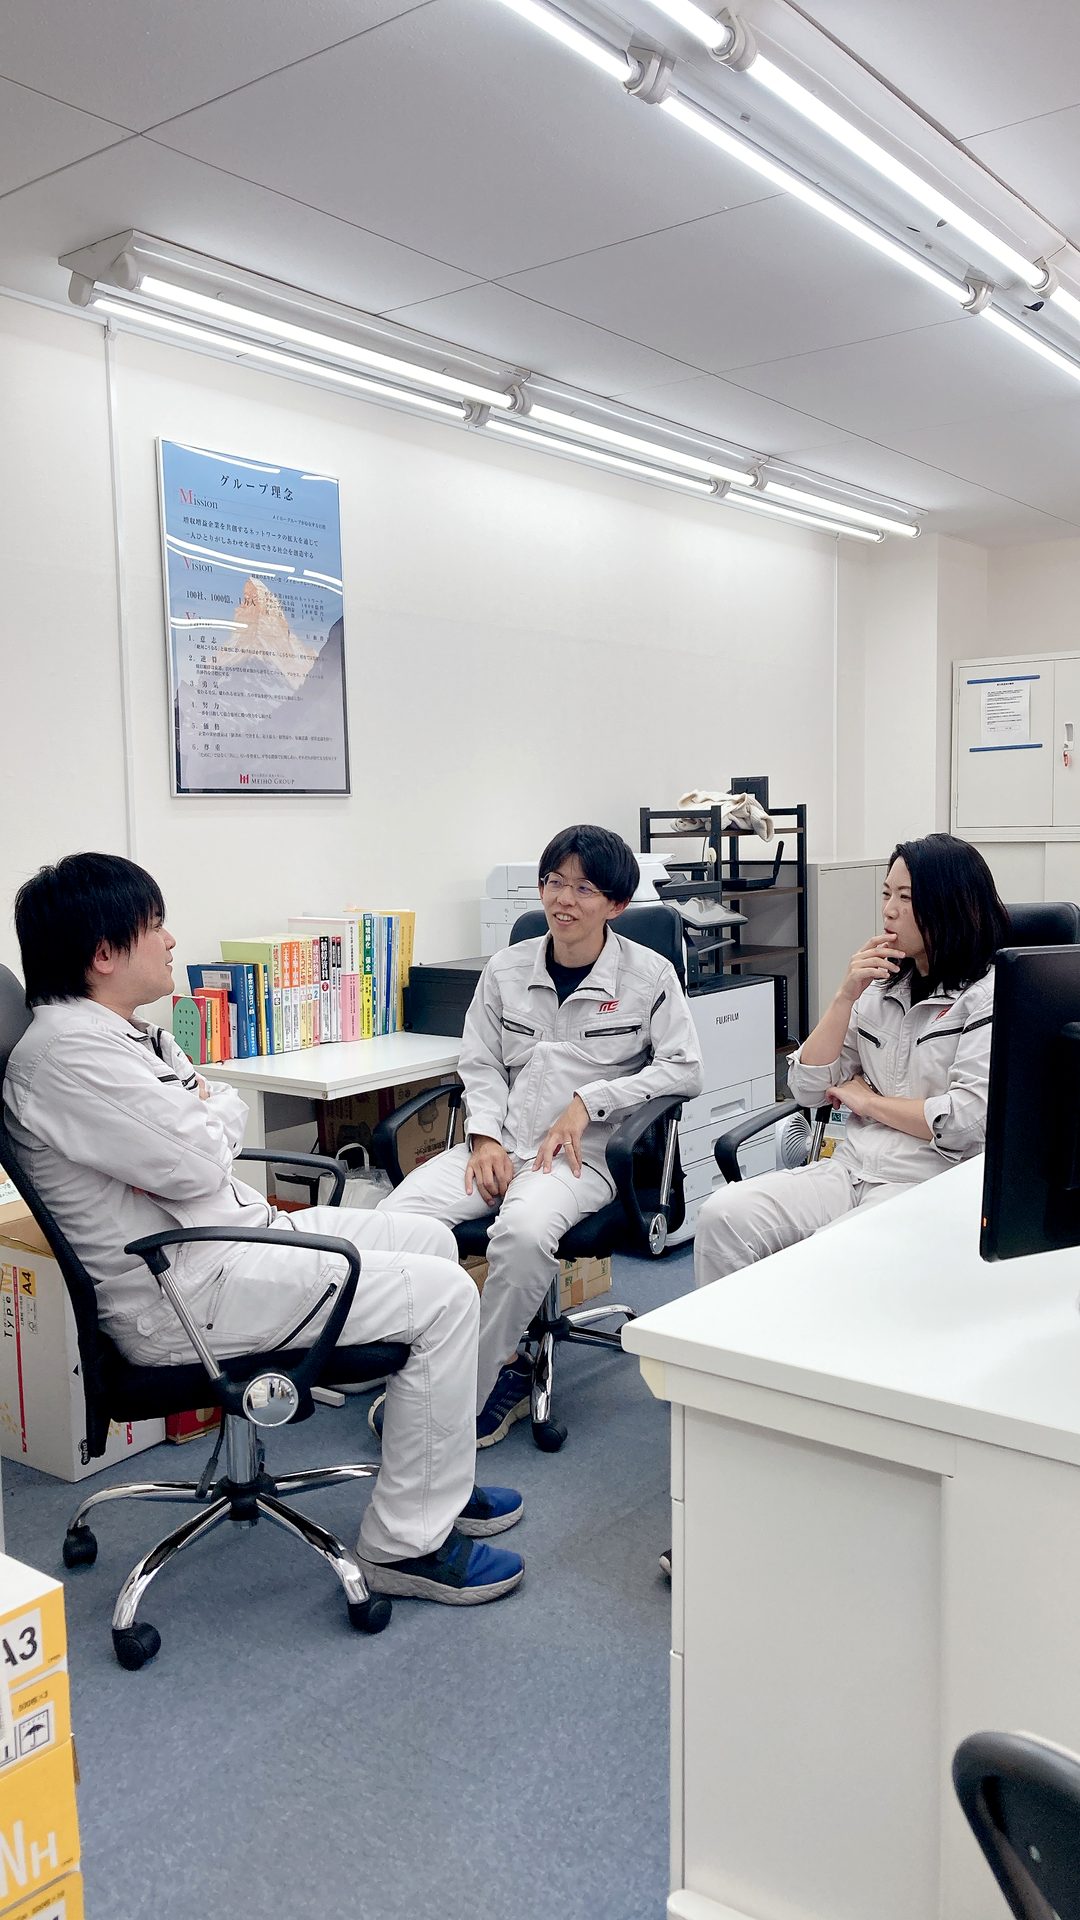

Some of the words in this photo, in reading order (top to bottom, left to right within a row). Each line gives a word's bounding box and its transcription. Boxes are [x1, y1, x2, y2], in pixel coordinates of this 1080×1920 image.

[179, 488, 218, 509] Mission
[220, 474, 294, 501] グループ理念
[184, 557, 213, 573] Vision
[715, 1012, 739, 1025] FUJIFILM
[22, 1271, 32, 1295] A4
[4, 1296, 14, 1338] Type
